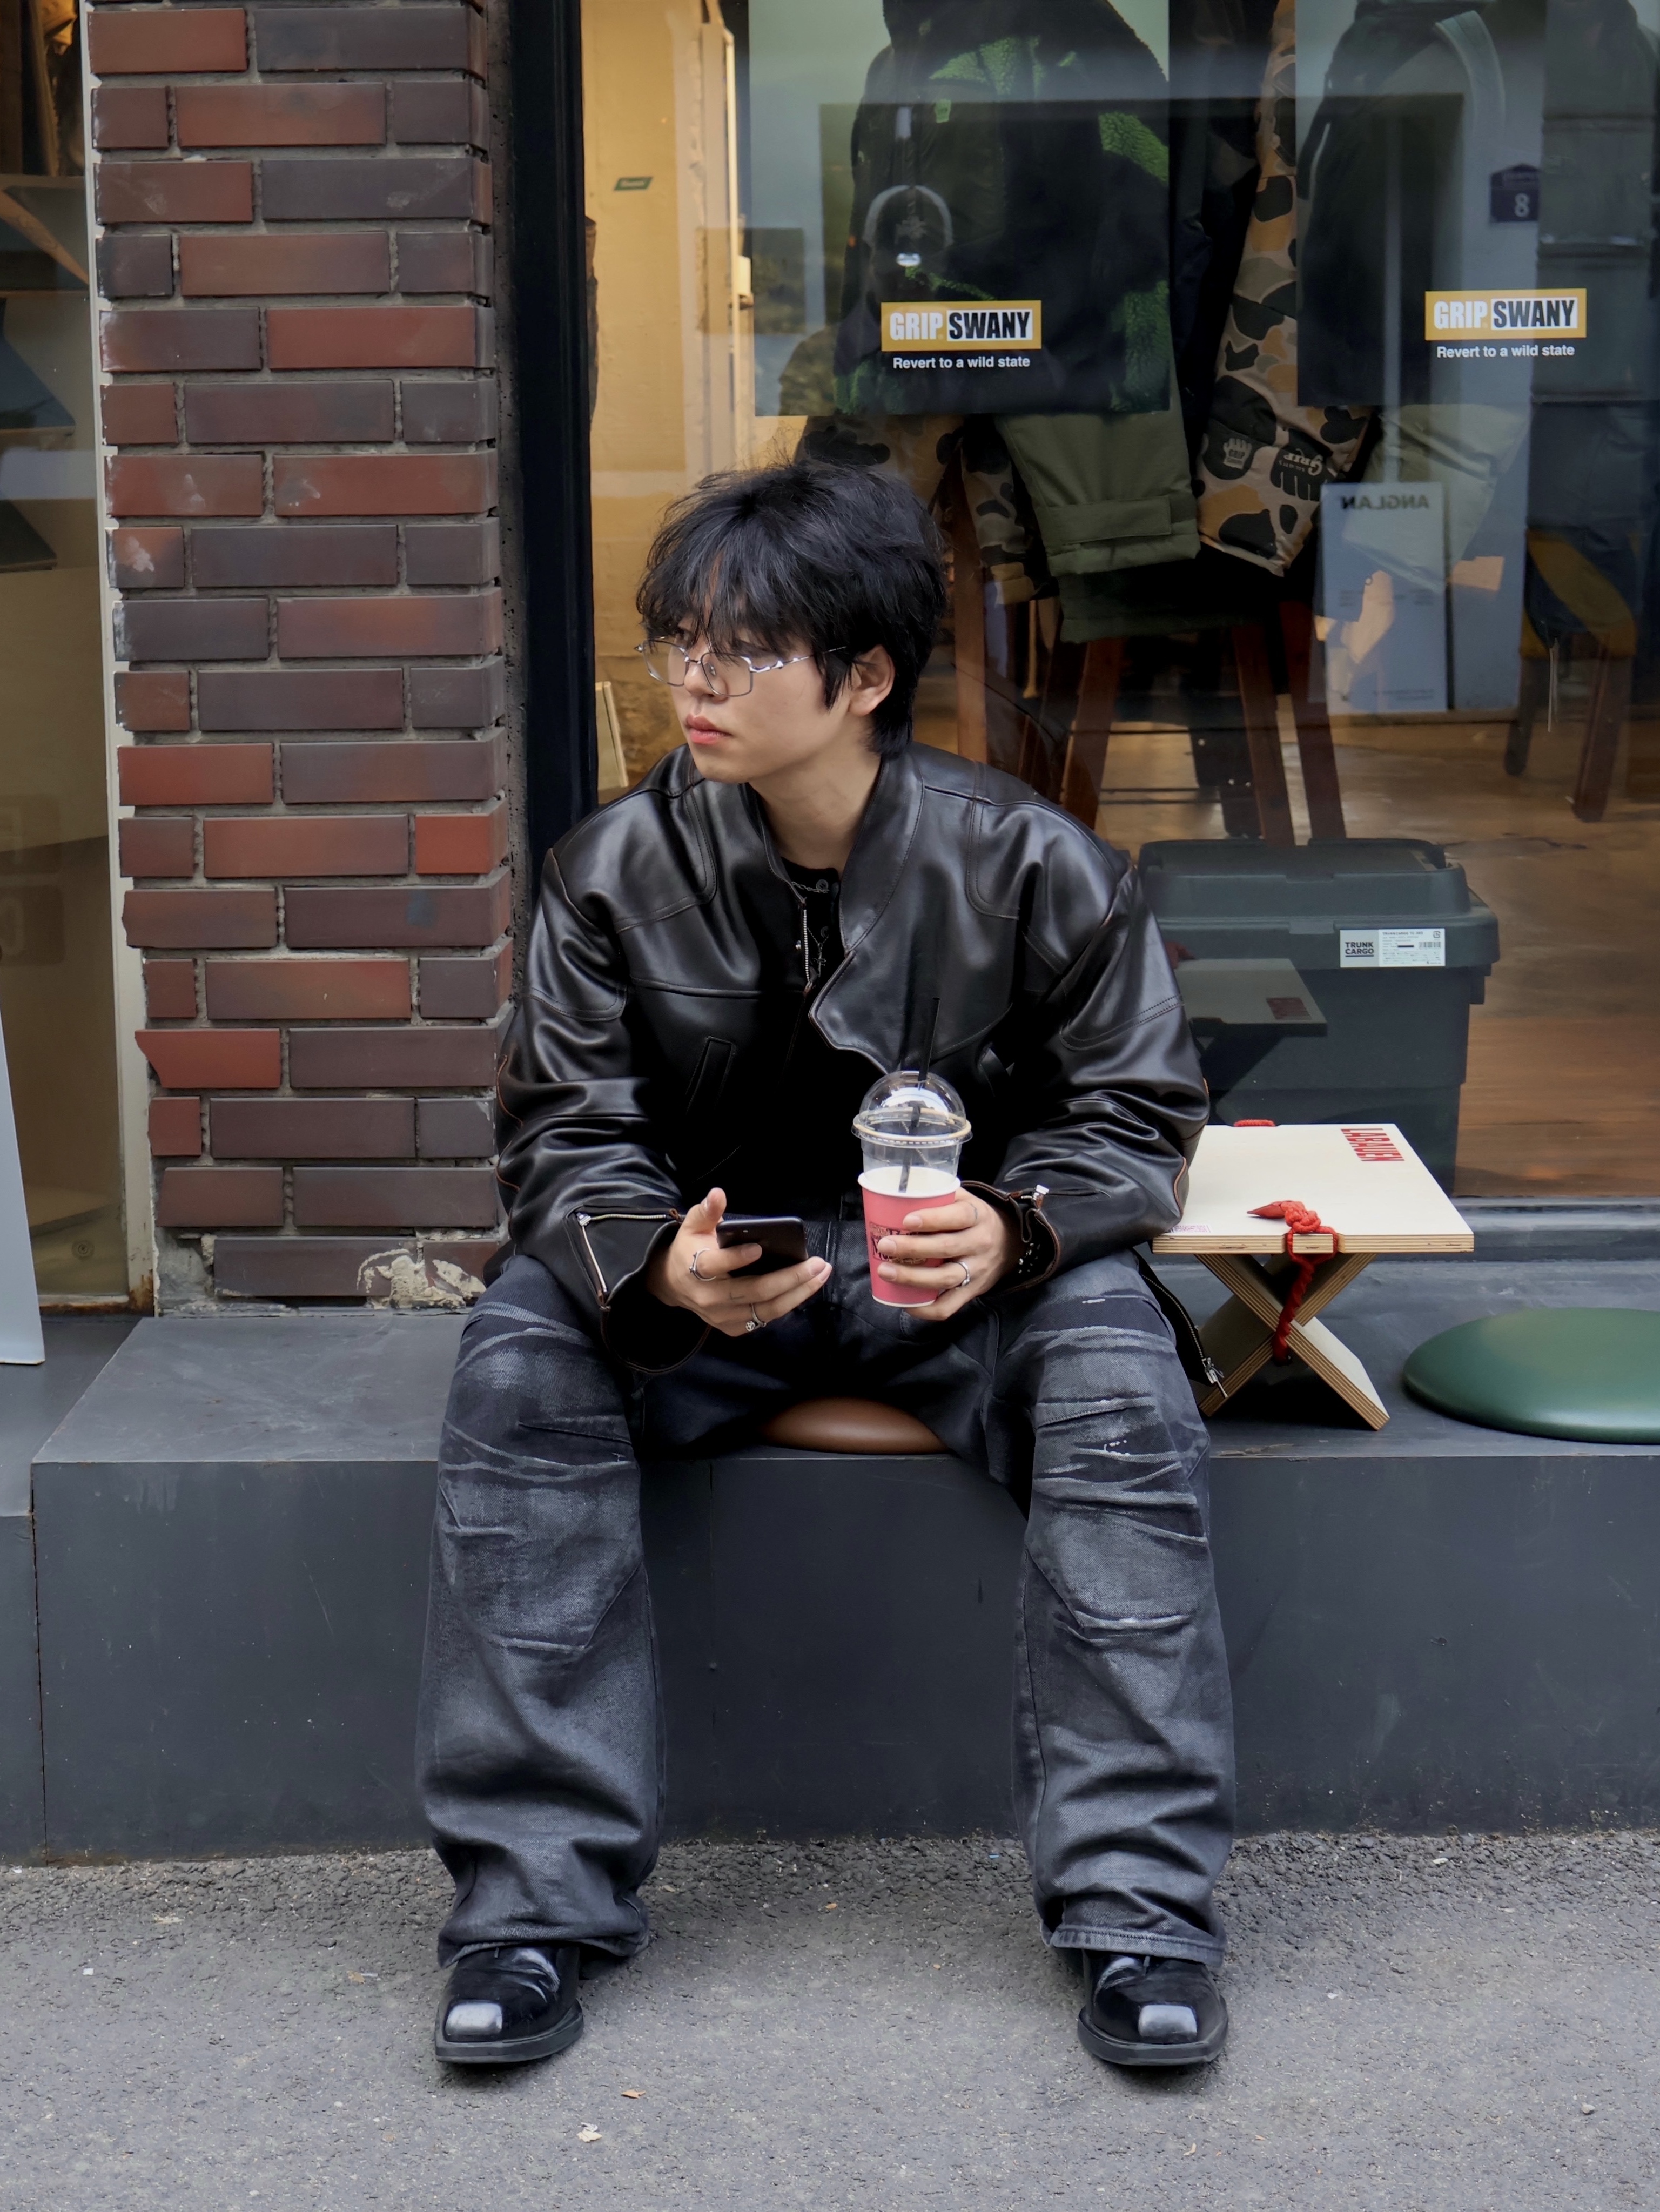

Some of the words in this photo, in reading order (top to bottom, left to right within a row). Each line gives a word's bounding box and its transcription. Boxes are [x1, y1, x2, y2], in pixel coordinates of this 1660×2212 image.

[1514, 192, 1530, 218] 8
[889, 312, 943, 341] GRIP
[949, 311, 1030, 340] SWANY
[1434, 300, 1488, 330] GRIP
[1493, 299, 1575, 328] SWANY
[893, 357, 936, 369] Revert
[939, 357, 953, 368] to
[956, 359, 964, 368] a
[967, 356, 994, 368] wild
[998, 356, 1031, 367] state
[1436, 346, 1480, 358] Revert
[1483, 346, 1497, 357] to
[1500, 348, 1508, 357] a
[1511, 345, 1539, 357] wild
[1542, 345, 1575, 357] state
[1340, 1128, 1406, 1161] LABAUEN
